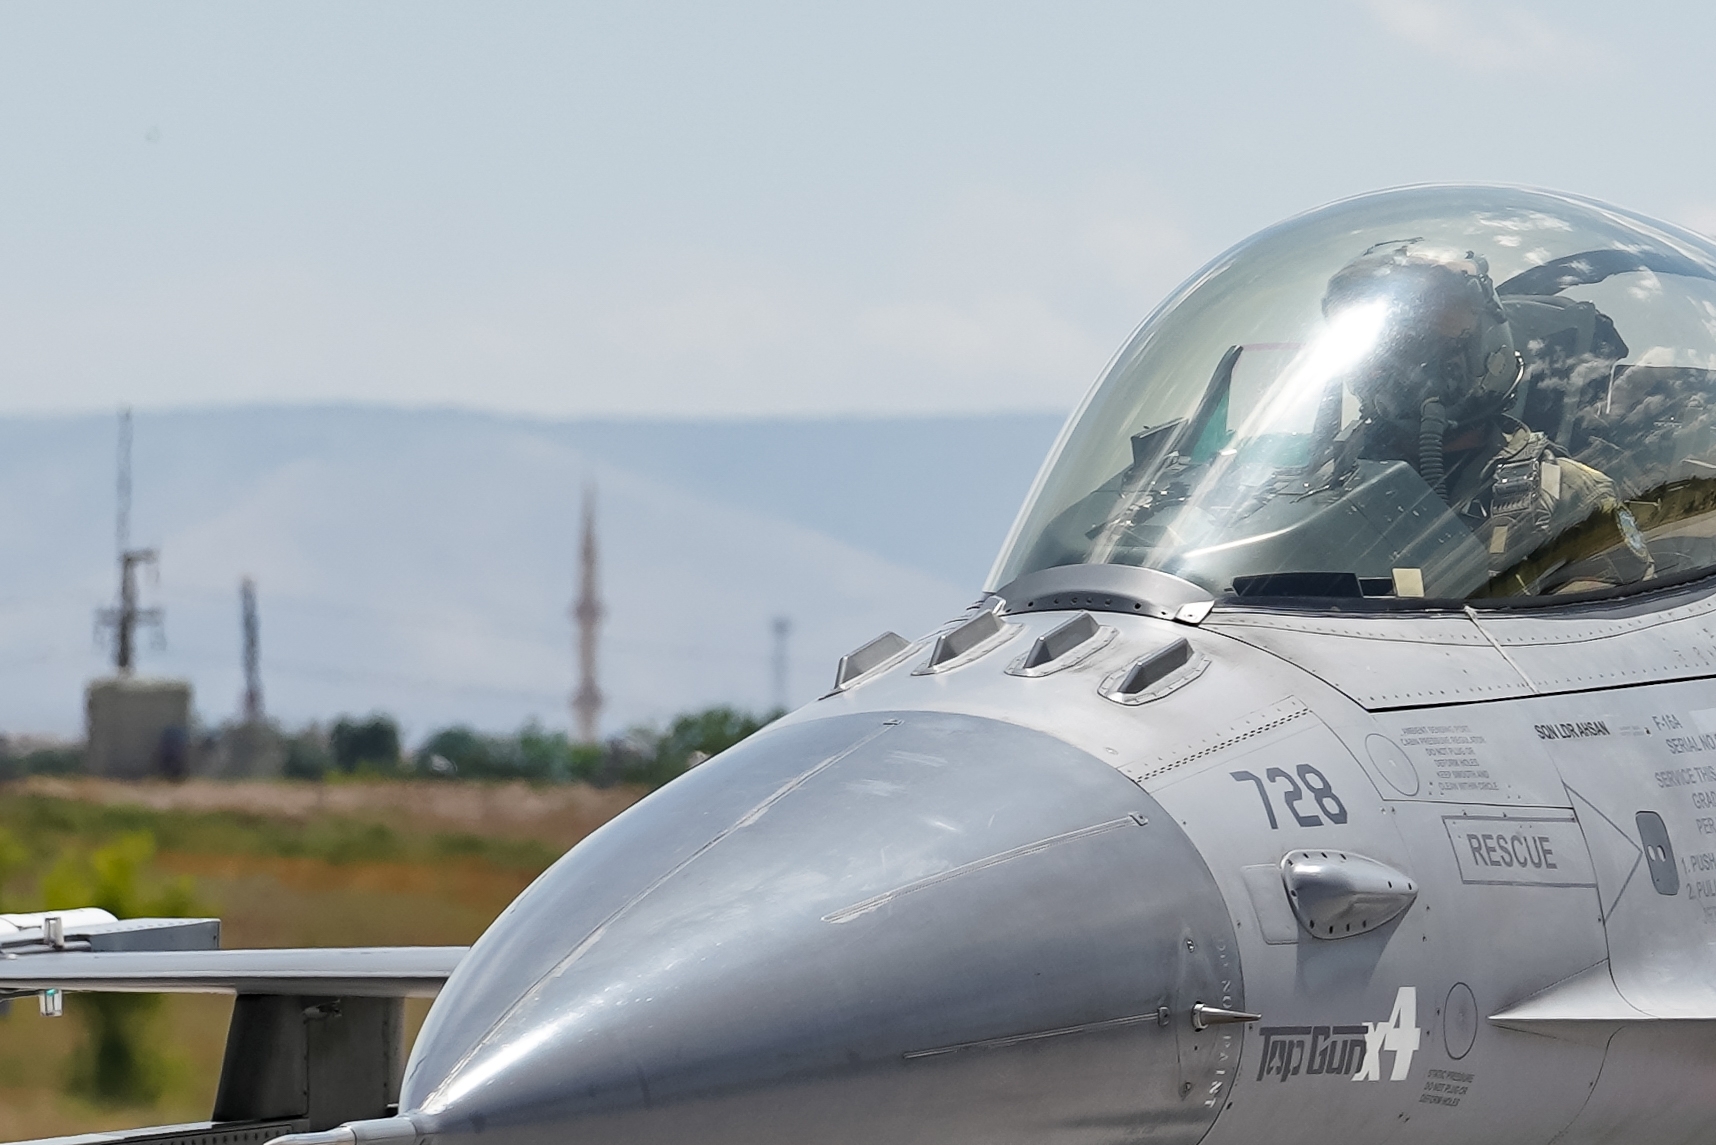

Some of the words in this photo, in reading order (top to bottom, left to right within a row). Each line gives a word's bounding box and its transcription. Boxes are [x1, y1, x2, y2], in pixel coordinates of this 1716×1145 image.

[1555, 723, 1580, 738] LDR
[1665, 737, 1703, 754] SERIAL
[1700, 734, 1716, 750] NO
[1655, 768, 1697, 788] SERVICE
[1229, 764, 1347, 829] 728
[1696, 818, 1716, 834] PER
[1466, 833, 1558, 869] RESCUE
[1681, 857, 1691, 875] 1.
[1690, 853, 1716, 872] PUSH
[1686, 883, 1697, 900] 2.
